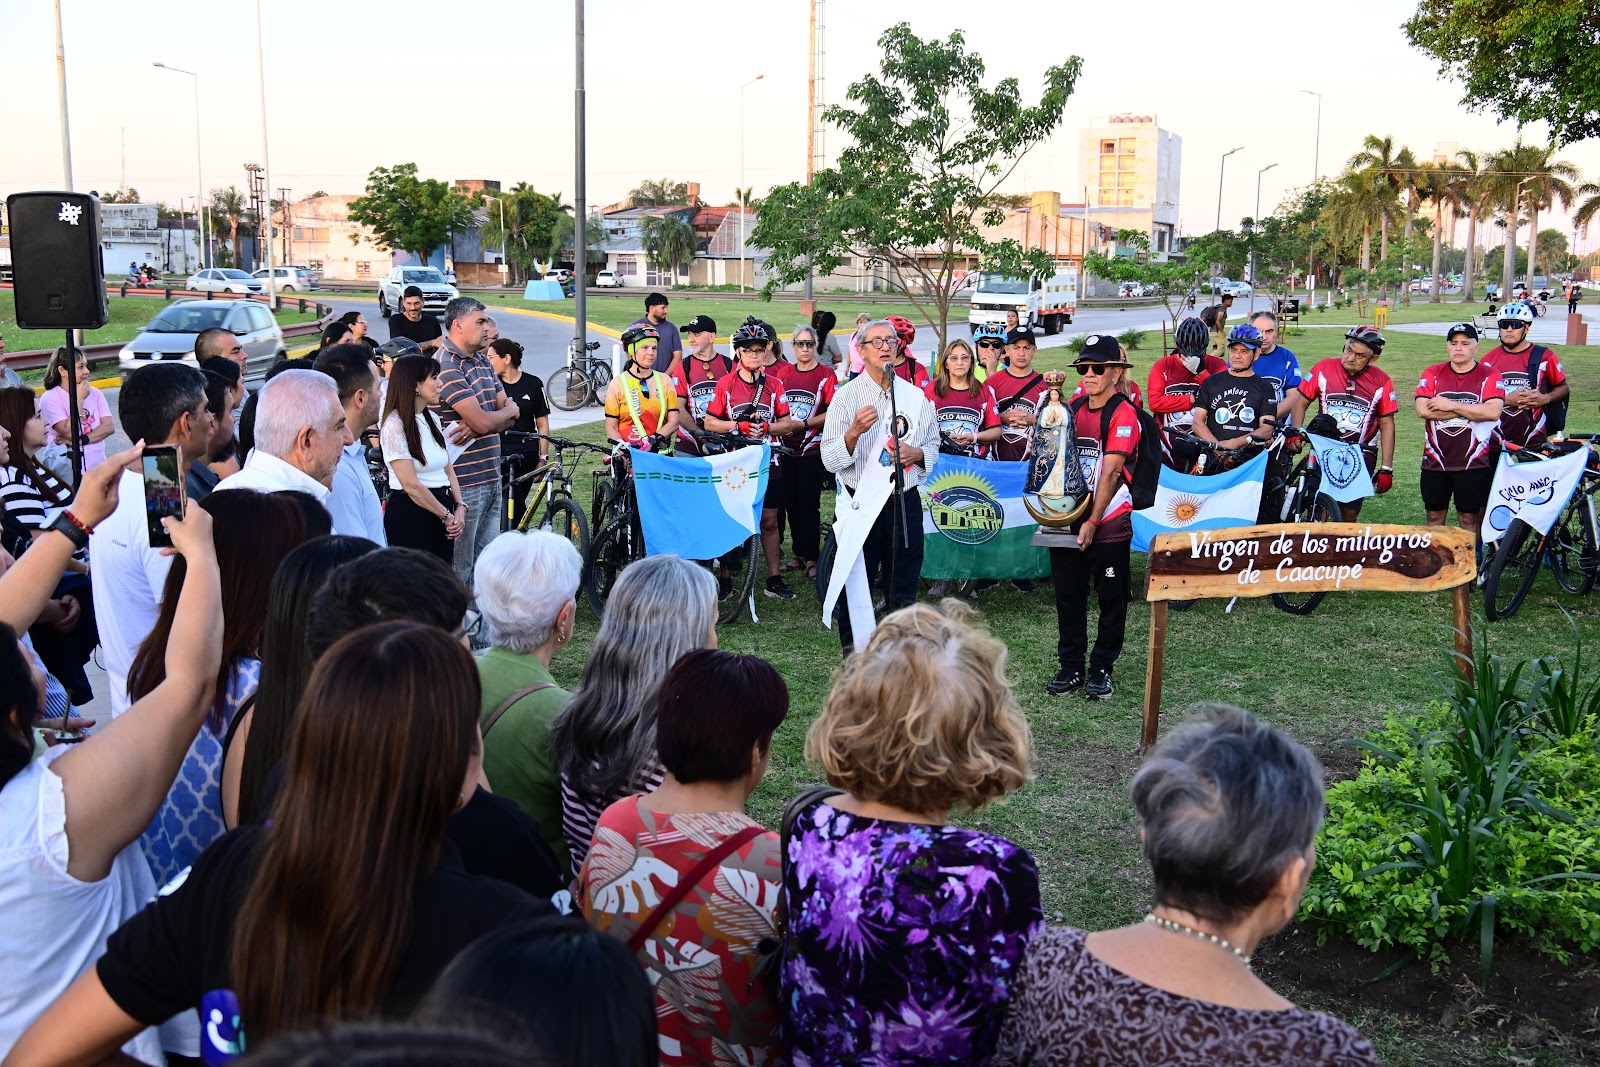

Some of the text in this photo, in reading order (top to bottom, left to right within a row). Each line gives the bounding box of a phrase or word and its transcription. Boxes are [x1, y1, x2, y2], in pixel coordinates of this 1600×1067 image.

[937, 413, 979, 425] CICLO AMIGOS
[1189, 526, 1432, 571] Virgen de los milagros
[1237, 557, 1366, 588] de Caacupé
